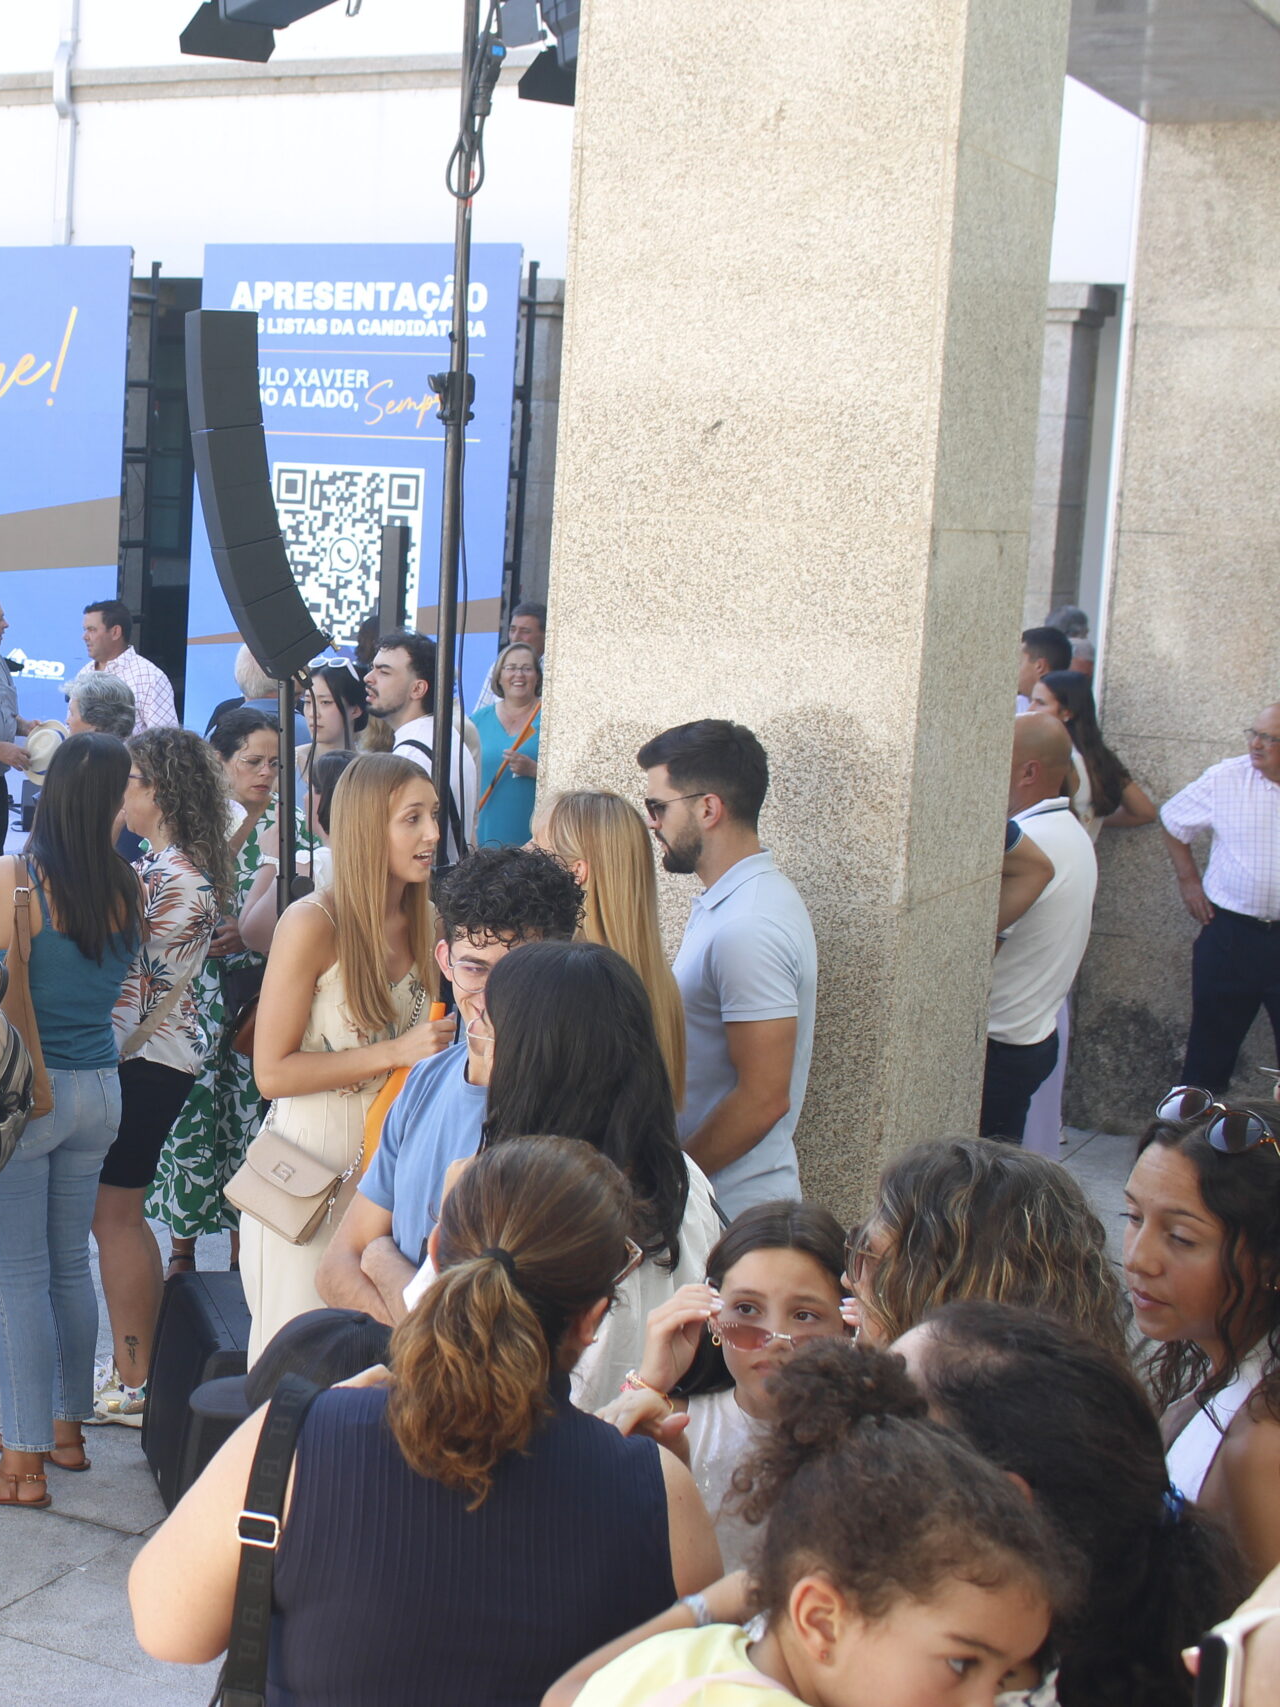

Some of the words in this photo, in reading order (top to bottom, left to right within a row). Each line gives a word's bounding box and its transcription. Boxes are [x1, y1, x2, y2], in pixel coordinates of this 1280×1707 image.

[266, 317, 328, 335] LISTAS
[329, 318, 355, 336] DA
[356, 318, 486, 338] CANDIDATA
[293, 367, 370, 389] XAVIER
[281, 387, 297, 407] A
[300, 388, 360, 413] LADO,
[22, 659, 65, 676] PSD
